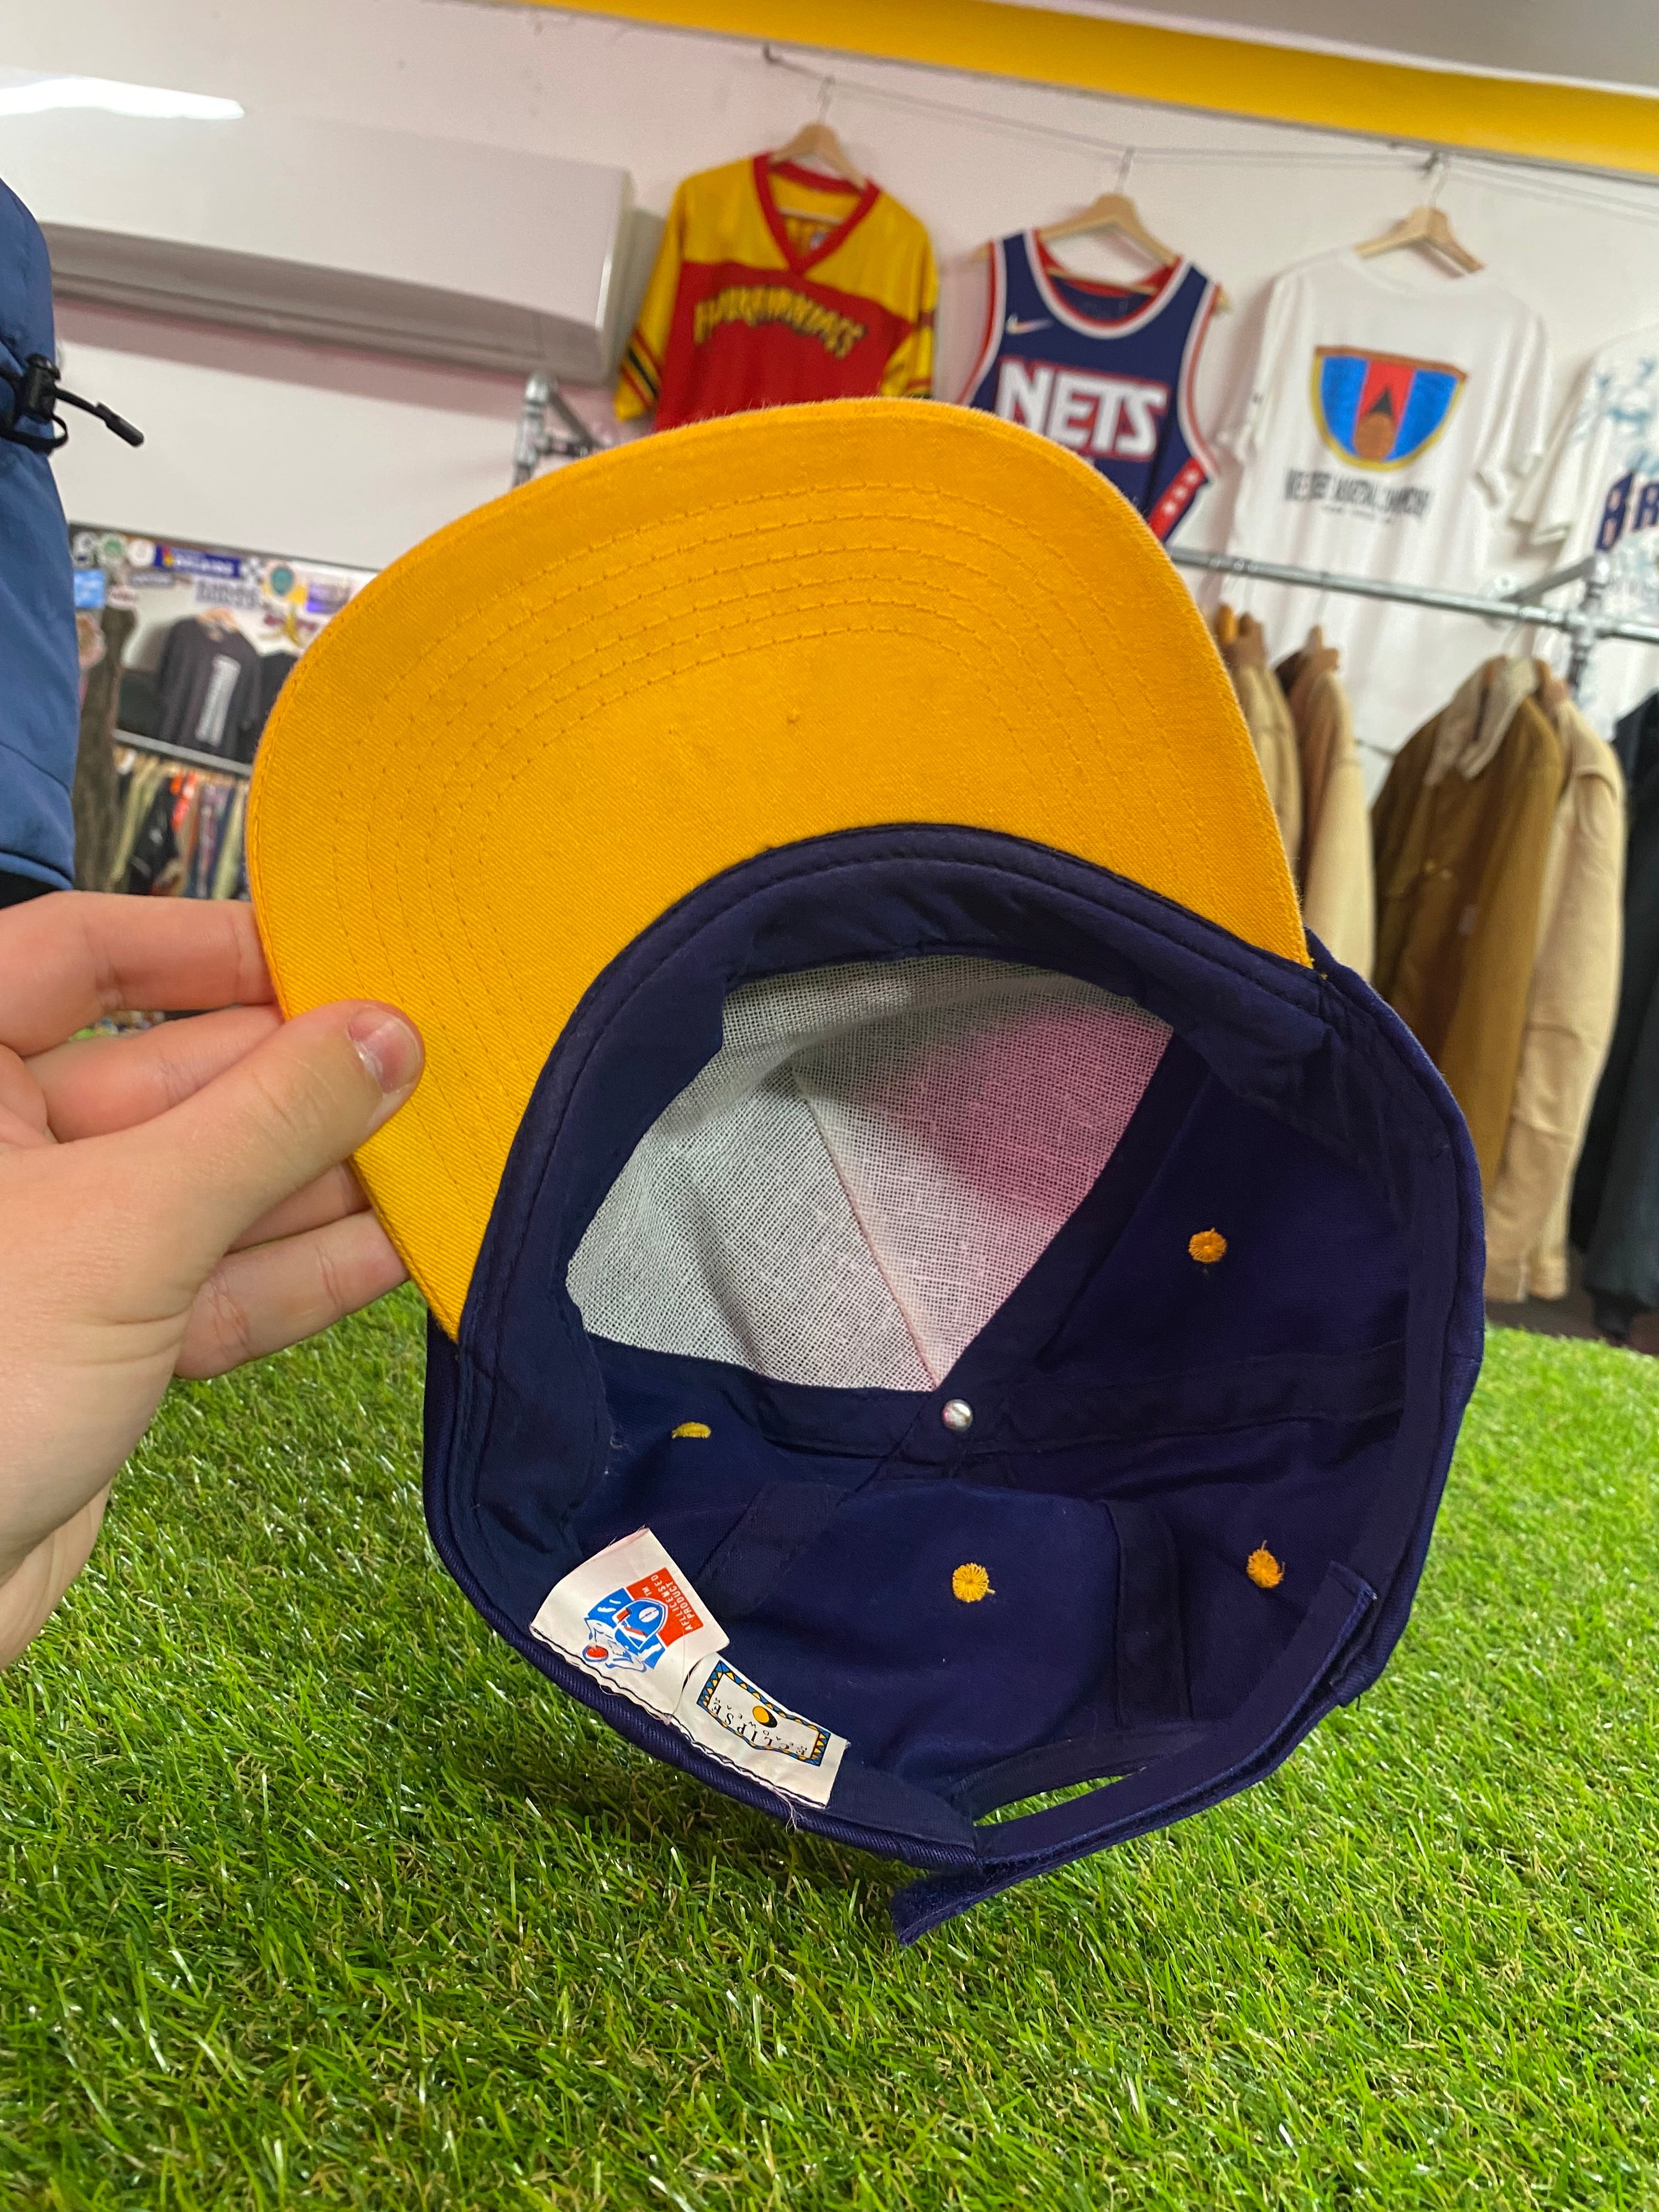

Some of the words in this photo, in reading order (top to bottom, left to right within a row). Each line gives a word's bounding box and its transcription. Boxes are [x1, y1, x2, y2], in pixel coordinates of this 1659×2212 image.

[995, 358, 1168, 460] NETS
[641, 1586, 652, 1597] TM
[666, 1581, 695, 1619] PRODUCT
[712, 1702, 806, 1756] ECLIPSE
